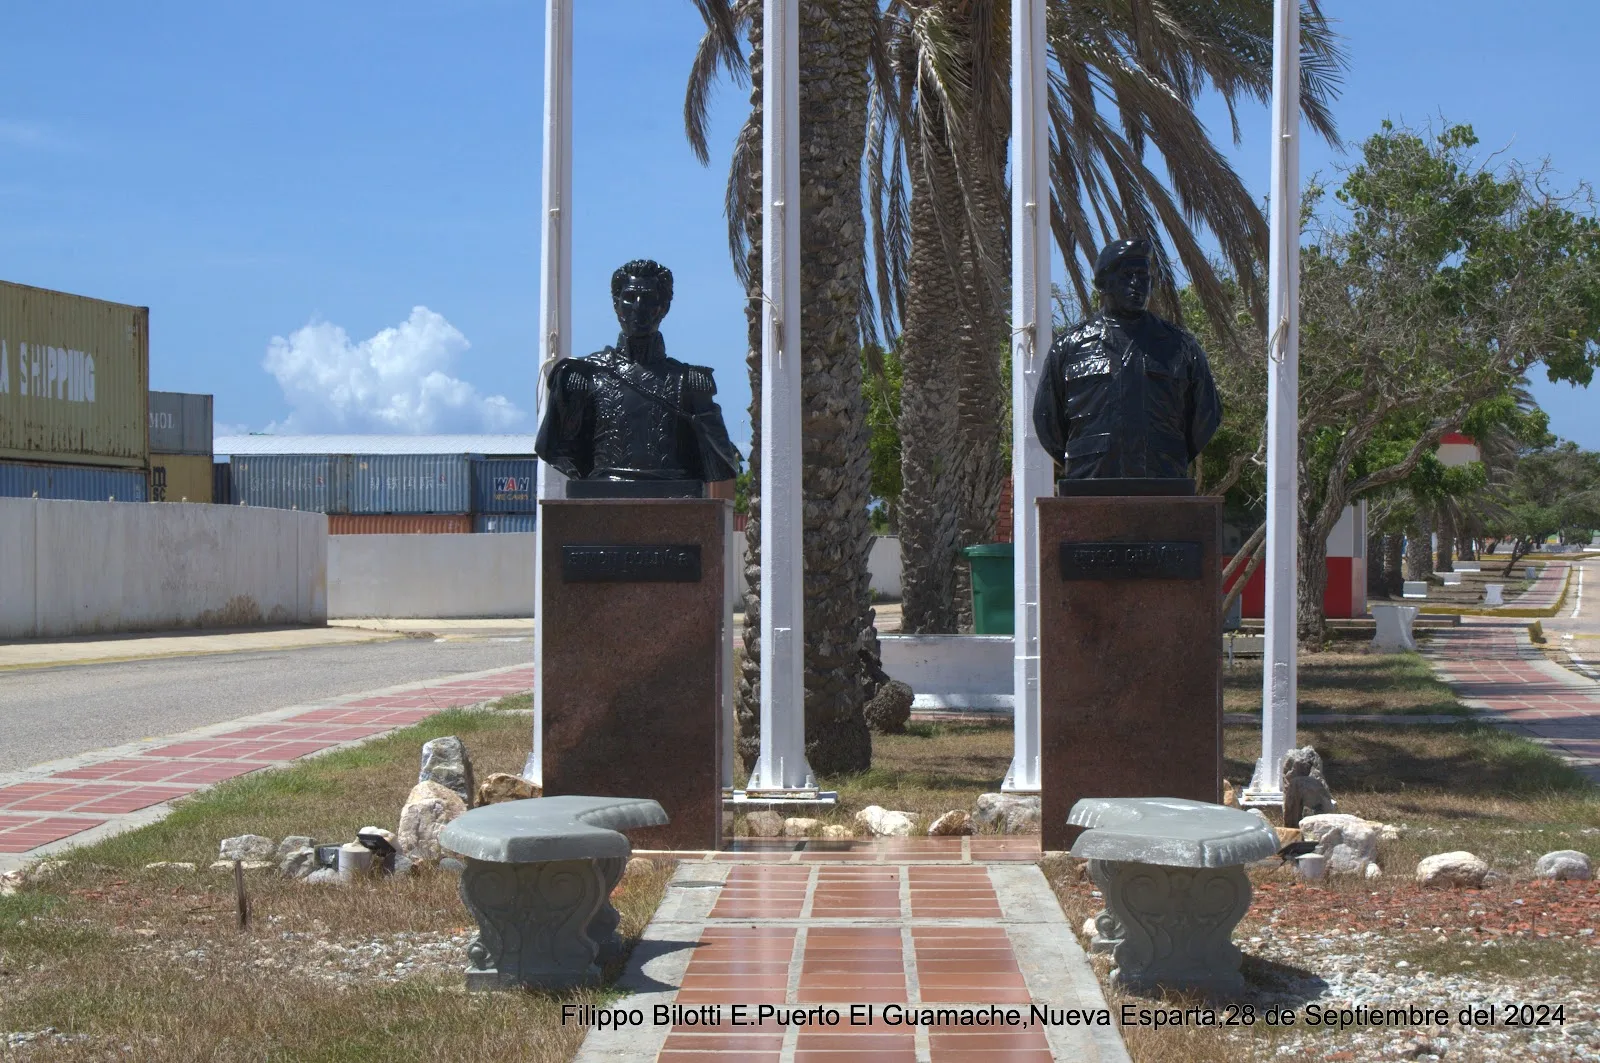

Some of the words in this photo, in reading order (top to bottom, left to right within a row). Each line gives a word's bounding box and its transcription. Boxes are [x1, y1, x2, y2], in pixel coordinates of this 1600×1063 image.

[20, 341, 96, 403] SHIPPING
[149, 412, 175, 430] MOL
[493, 476, 530, 492] WAN
